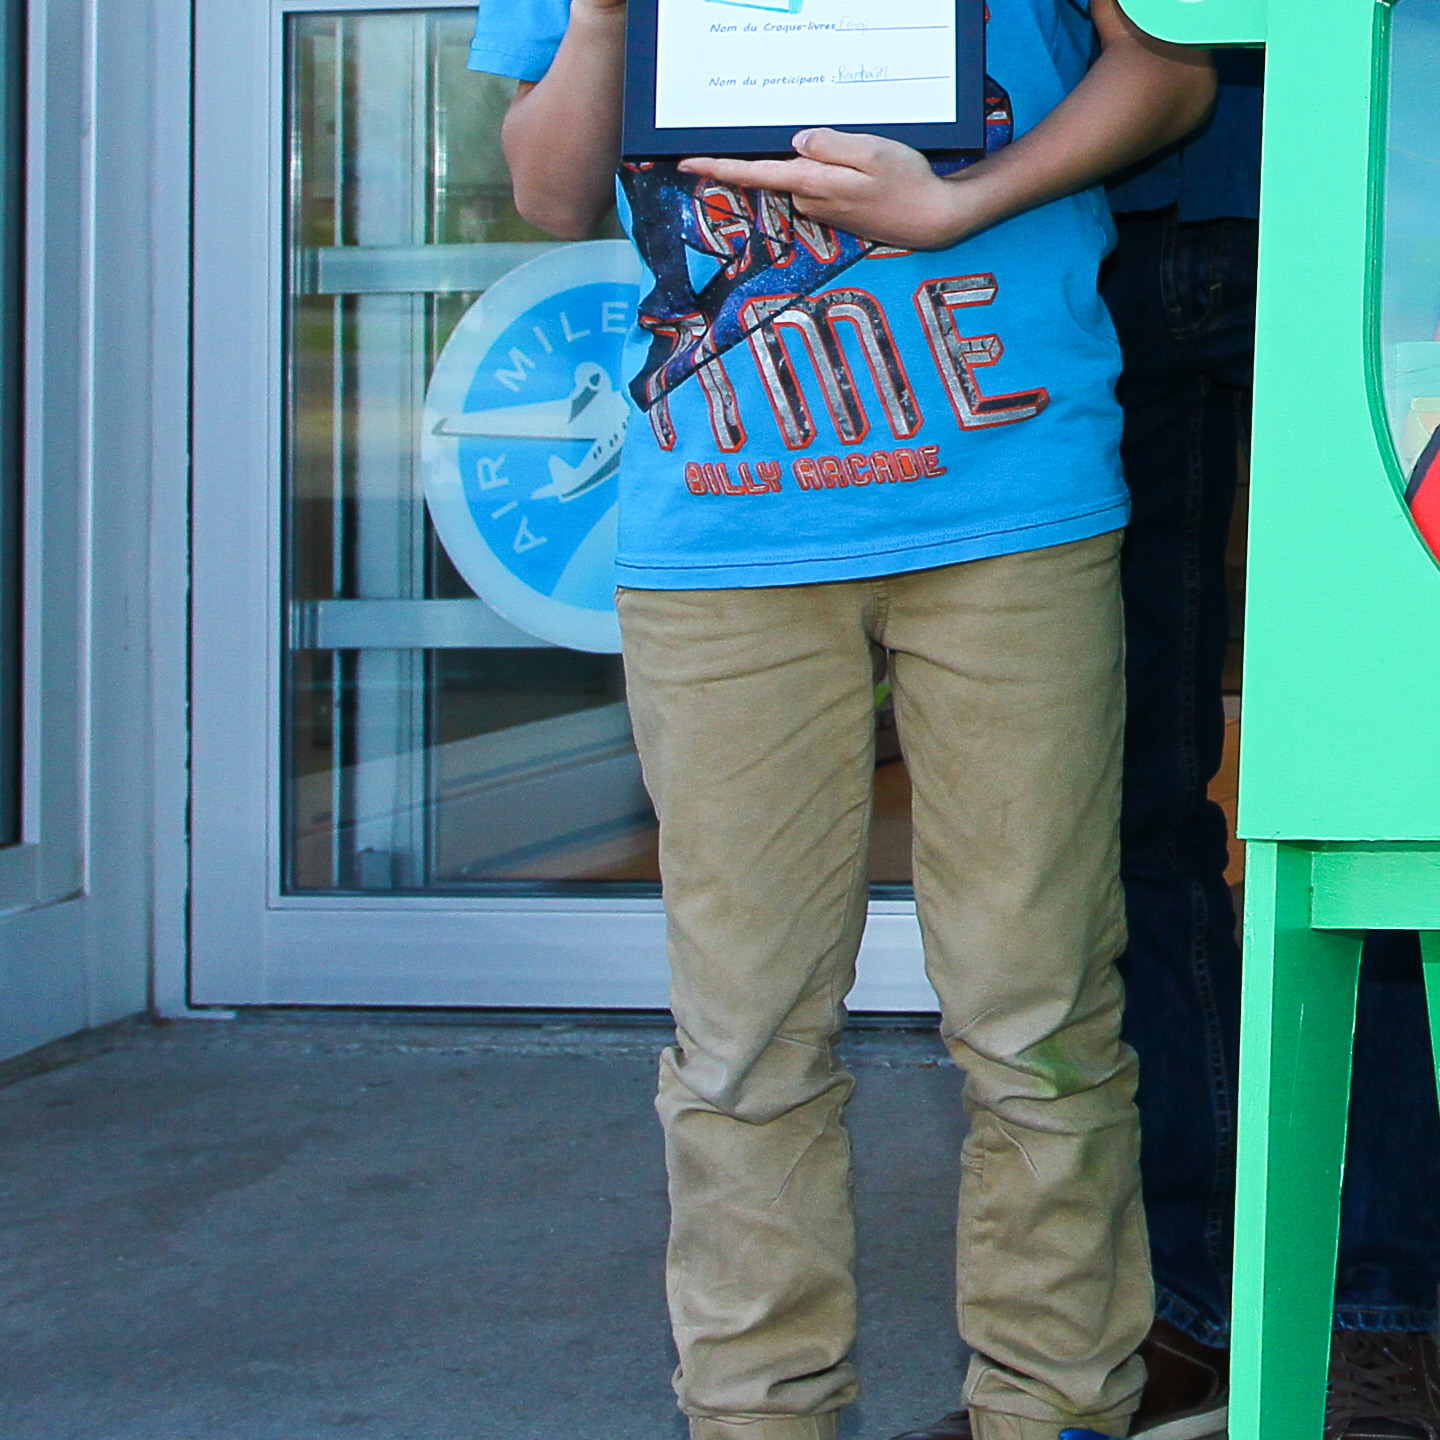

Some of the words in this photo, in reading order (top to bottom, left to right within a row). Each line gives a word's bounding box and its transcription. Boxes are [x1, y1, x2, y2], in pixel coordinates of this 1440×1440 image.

[709, 23, 737, 33] Nom
[743, 22, 757, 33] du
[763, 21, 836, 34] Croque-livres
[708, 77, 737, 88] Nom
[743, 76, 757, 86] du
[762, 74, 826, 89] participant
[685, 461, 782, 496] BILLY
[793, 445, 948, 491] ARCADE
[477, 452, 549, 555] AIR
